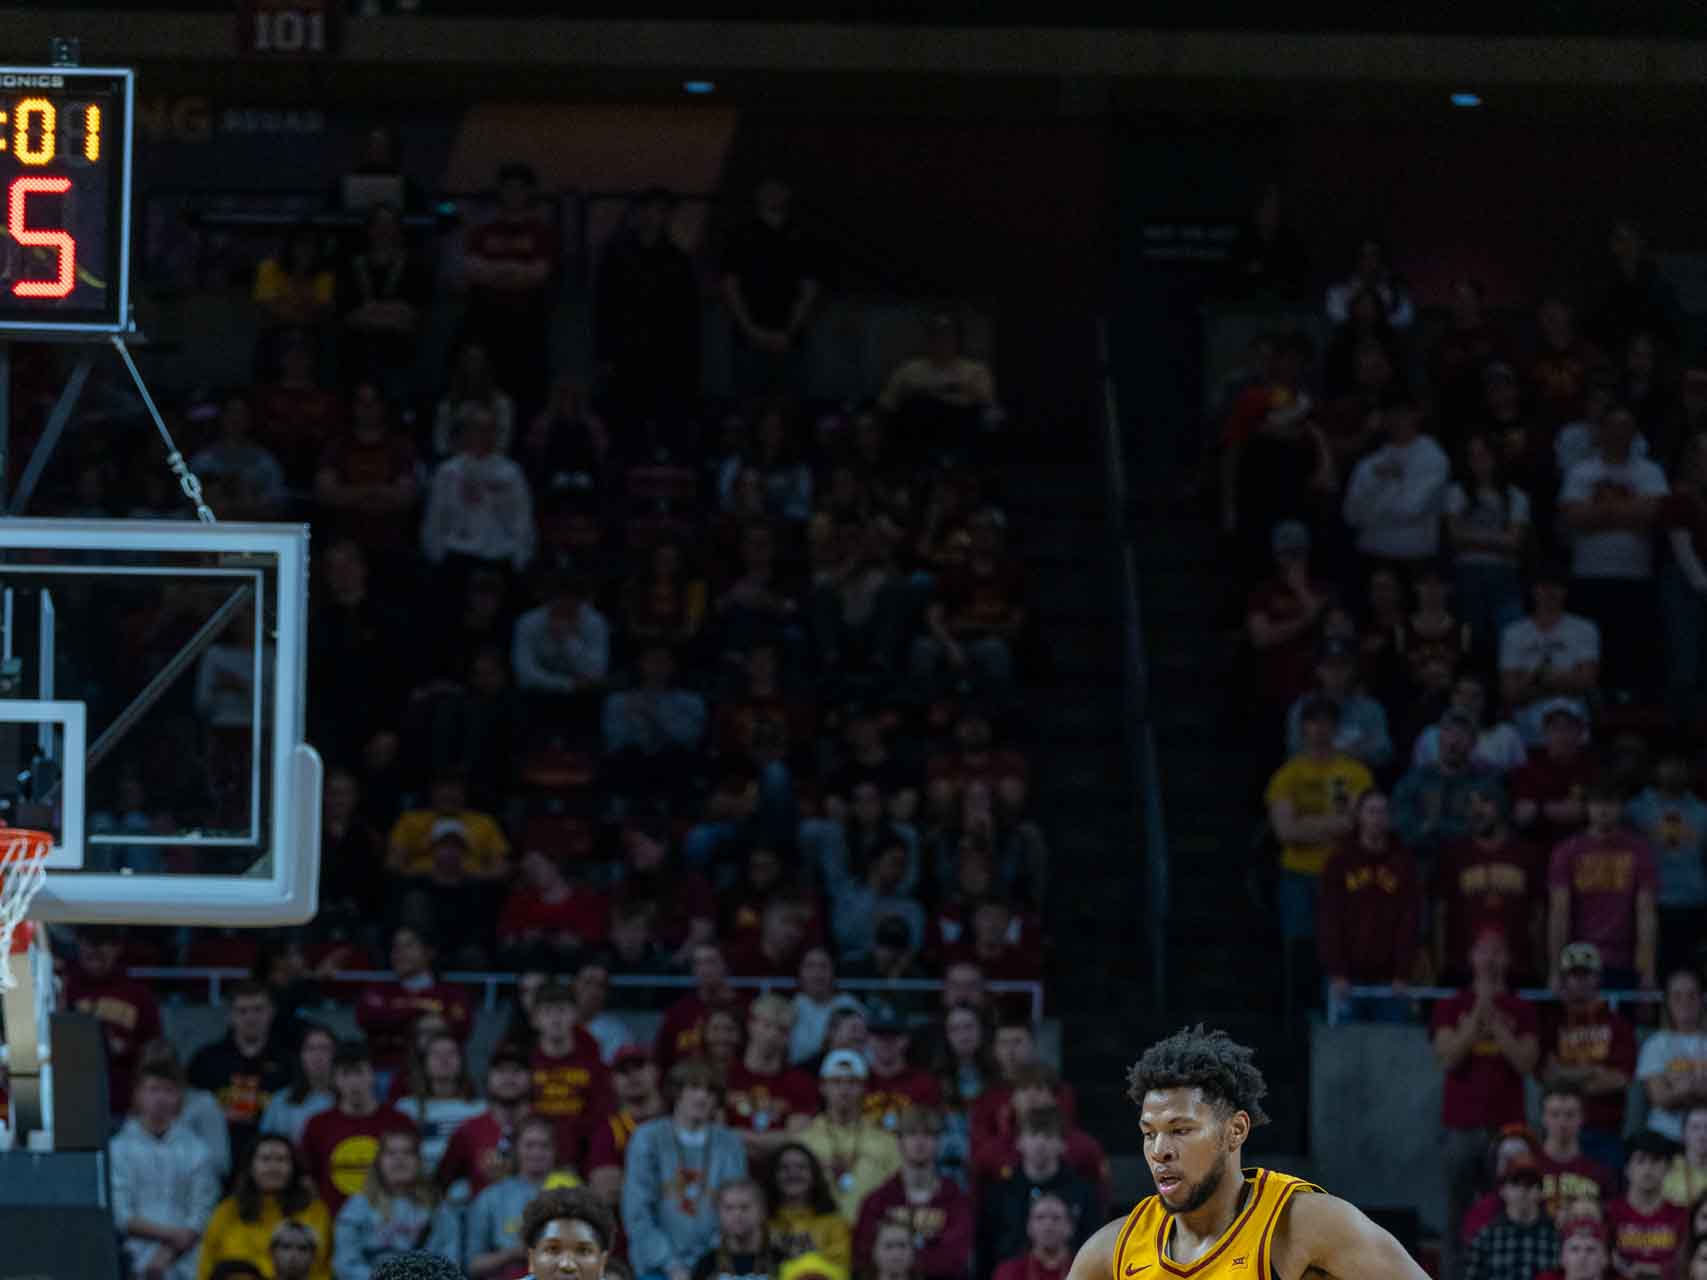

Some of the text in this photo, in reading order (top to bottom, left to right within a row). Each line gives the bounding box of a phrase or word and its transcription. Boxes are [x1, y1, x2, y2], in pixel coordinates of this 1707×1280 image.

[254, 14, 325, 50] 101
[0, 75, 64, 89] ONICS
[7, 175, 76, 299] 5
